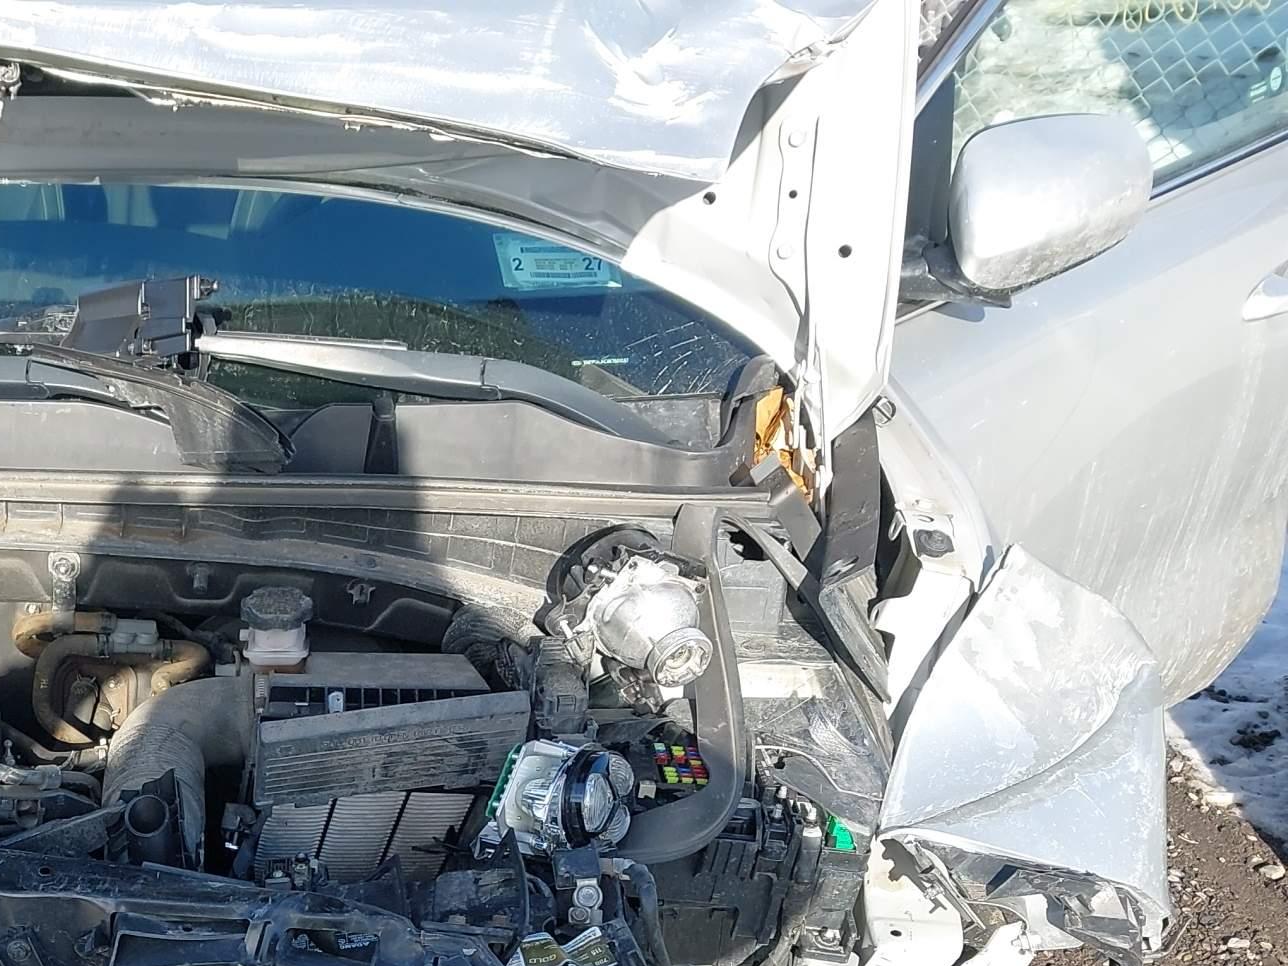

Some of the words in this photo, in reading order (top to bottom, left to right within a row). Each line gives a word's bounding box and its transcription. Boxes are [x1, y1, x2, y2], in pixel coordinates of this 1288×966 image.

[512, 257, 524, 271] 2
[582, 257, 602, 271] 27
[528, 953, 557, 965] GOLD
